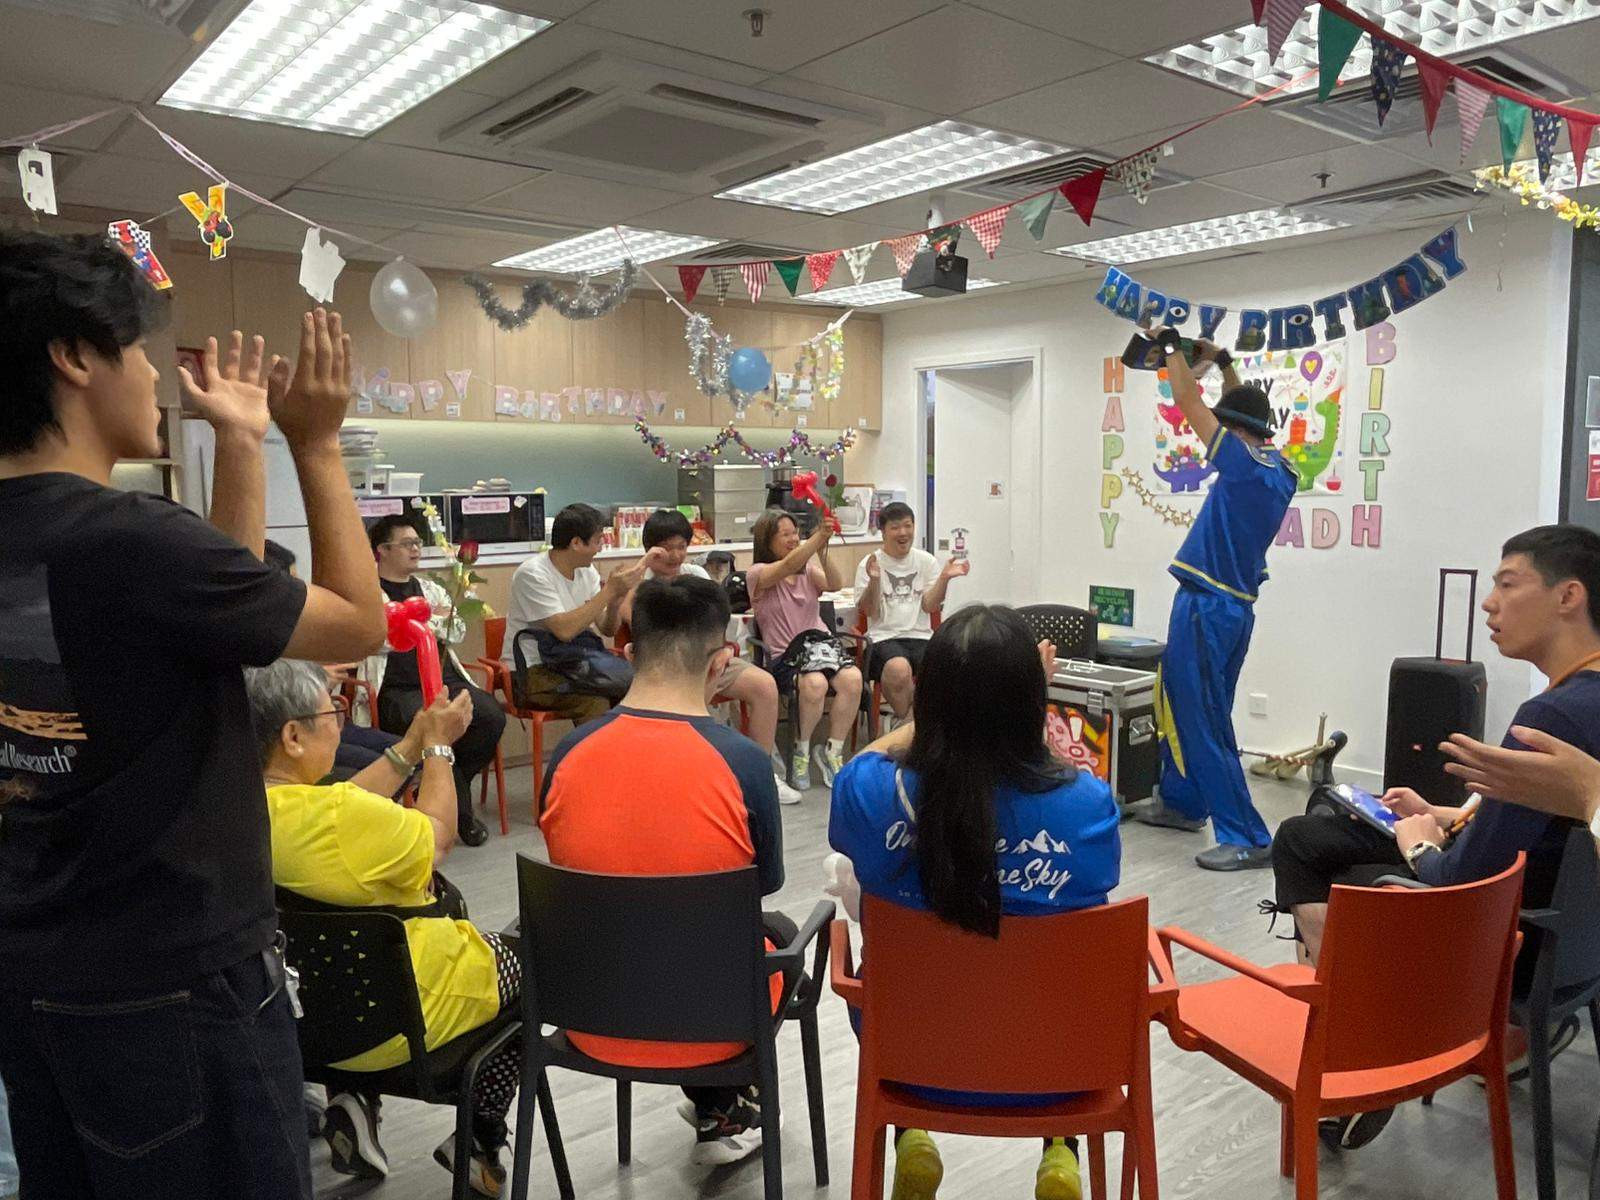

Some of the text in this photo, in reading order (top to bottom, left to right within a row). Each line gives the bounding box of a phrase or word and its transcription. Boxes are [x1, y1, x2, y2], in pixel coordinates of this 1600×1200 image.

[1096, 226, 1467, 352] HAPPY BIRTHDAY
[495, 385, 669, 422] BIRTHDAY
[1100, 356, 1125, 549] HAPPY
